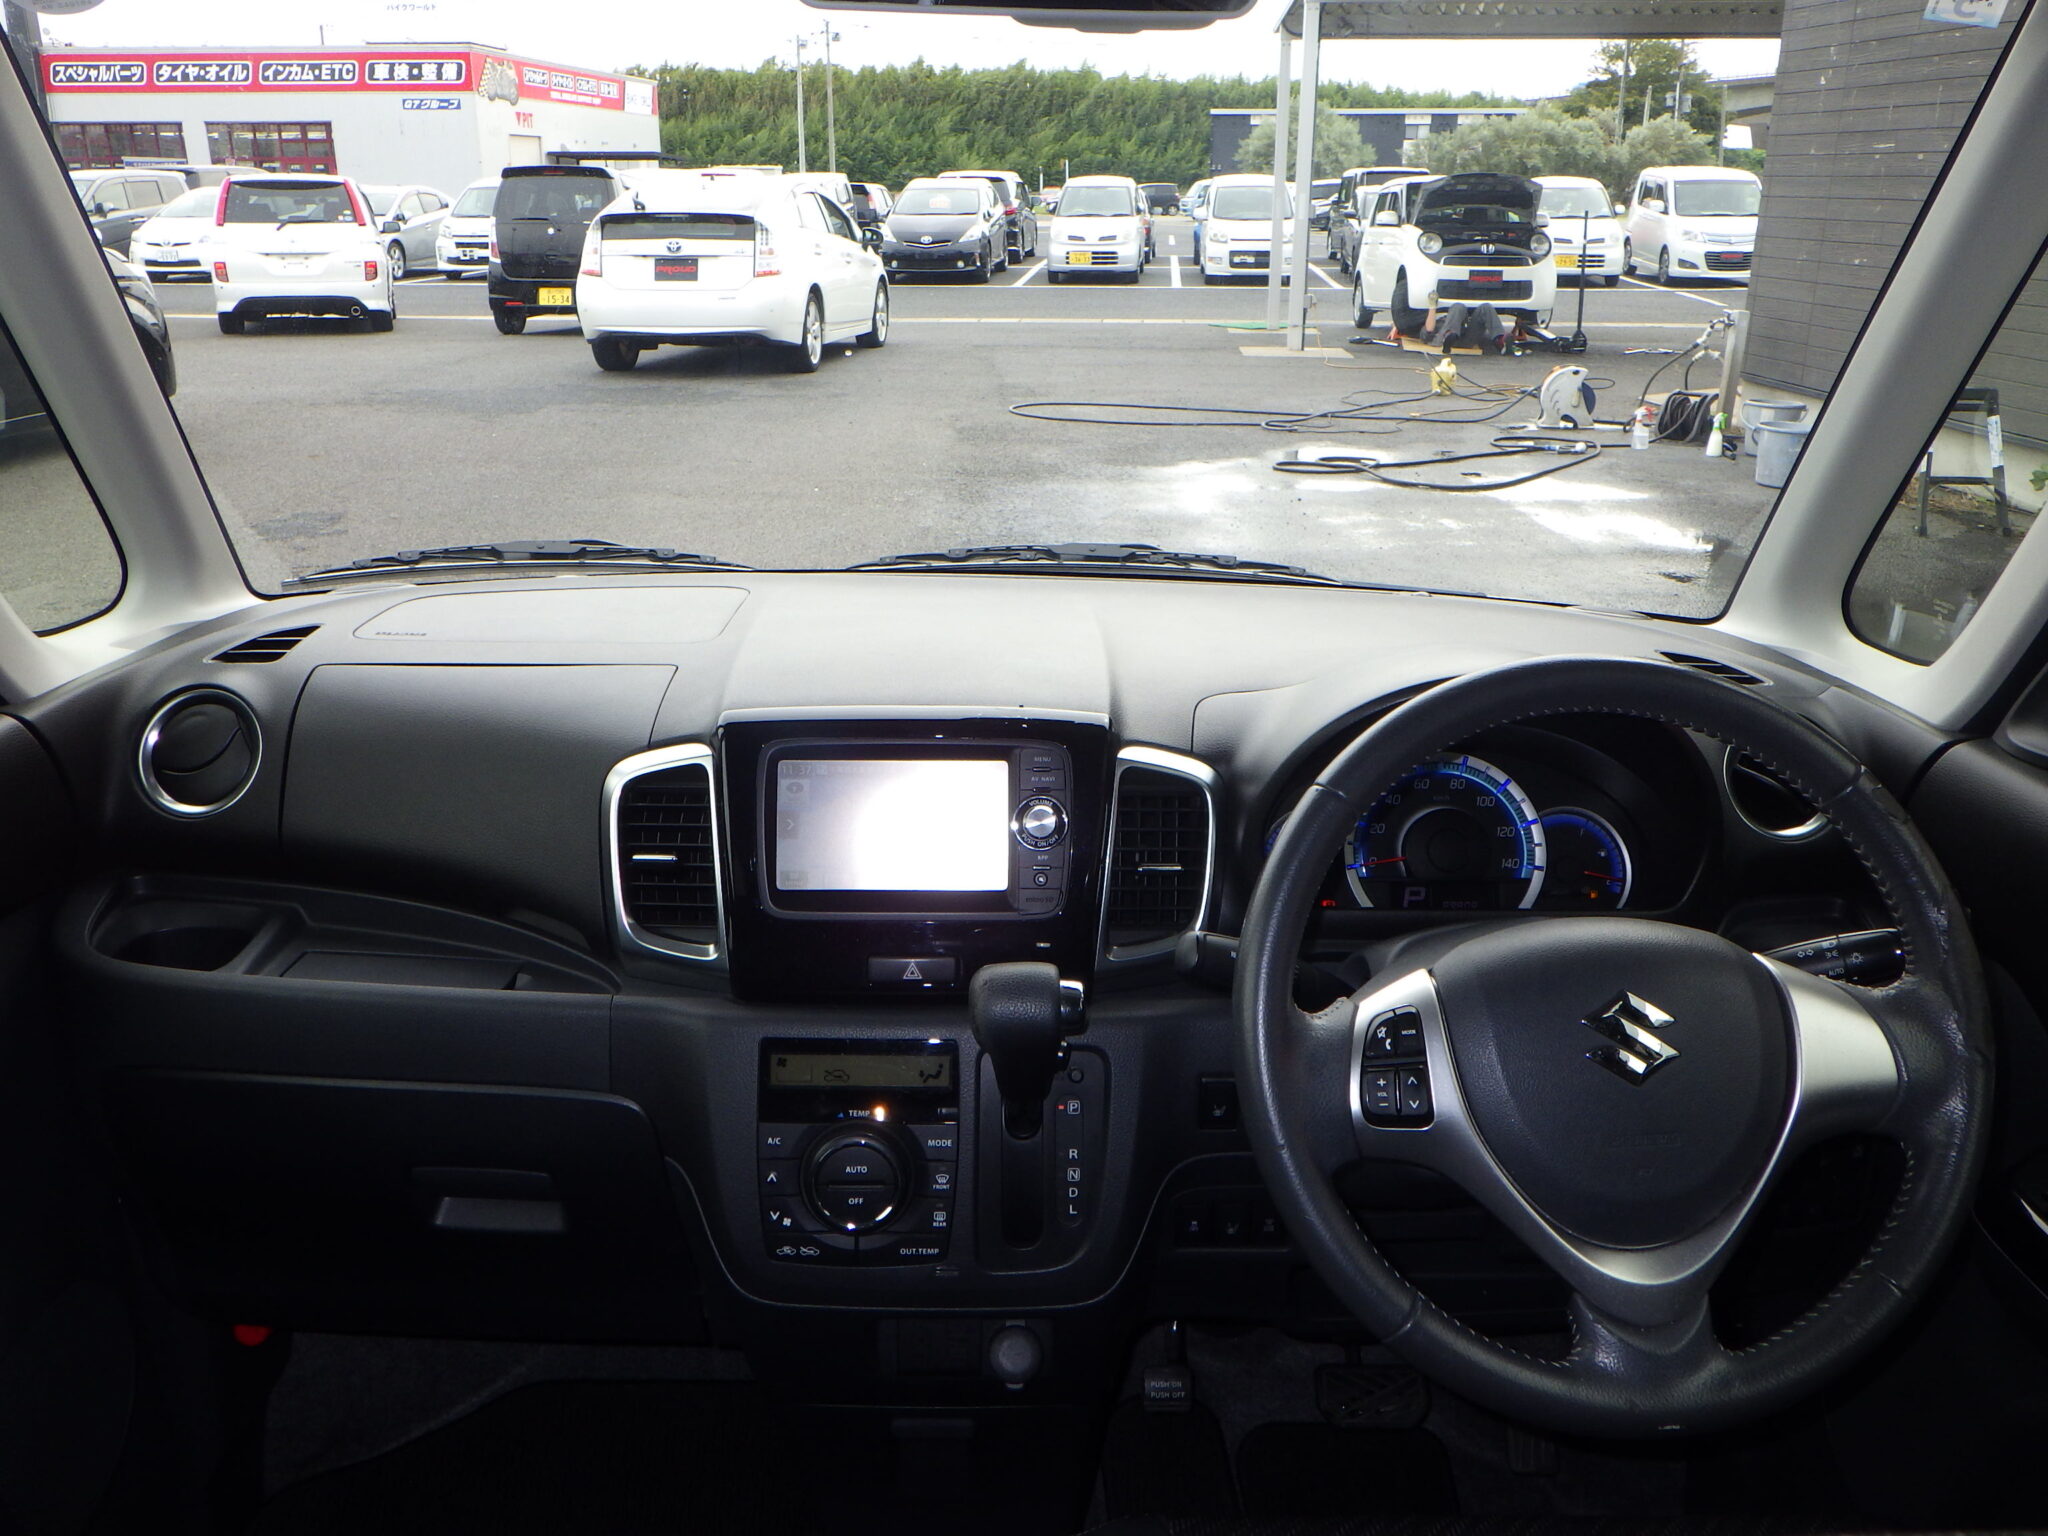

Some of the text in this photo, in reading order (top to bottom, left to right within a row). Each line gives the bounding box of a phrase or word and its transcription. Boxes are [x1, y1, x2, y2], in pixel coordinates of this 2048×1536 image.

[54, 65, 142, 82] スペシャルパーツ
[158, 64, 248, 82] タイヤ・オイル
[264, 63, 354, 81] インカム・ETC
[373, 63, 458, 81] 車検・整備
[1449, 779, 1466, 789] 80
[1476, 796, 1496, 807] 100
[1370, 823, 1386, 834] 20
[1497, 826, 1516, 837] 120
[1501, 858, 1520, 869] 140
[1403, 886, 1426, 908] P
[1829, 967, 1845, 977] AUTO
[848, 1110, 871, 1118] TEMP
[767, 1137, 781, 1145] A/C
[927, 1139, 953, 1147] MODE
[1069, 1149, 1078, 1159] R
[845, 1166, 868, 1174] AUTO
[1069, 1187, 1078, 1197] D
[848, 1197, 864, 1205] OFF
[1069, 1204, 1078, 1214] L
[1151, 1391, 1185, 1399] PUSH OFF
